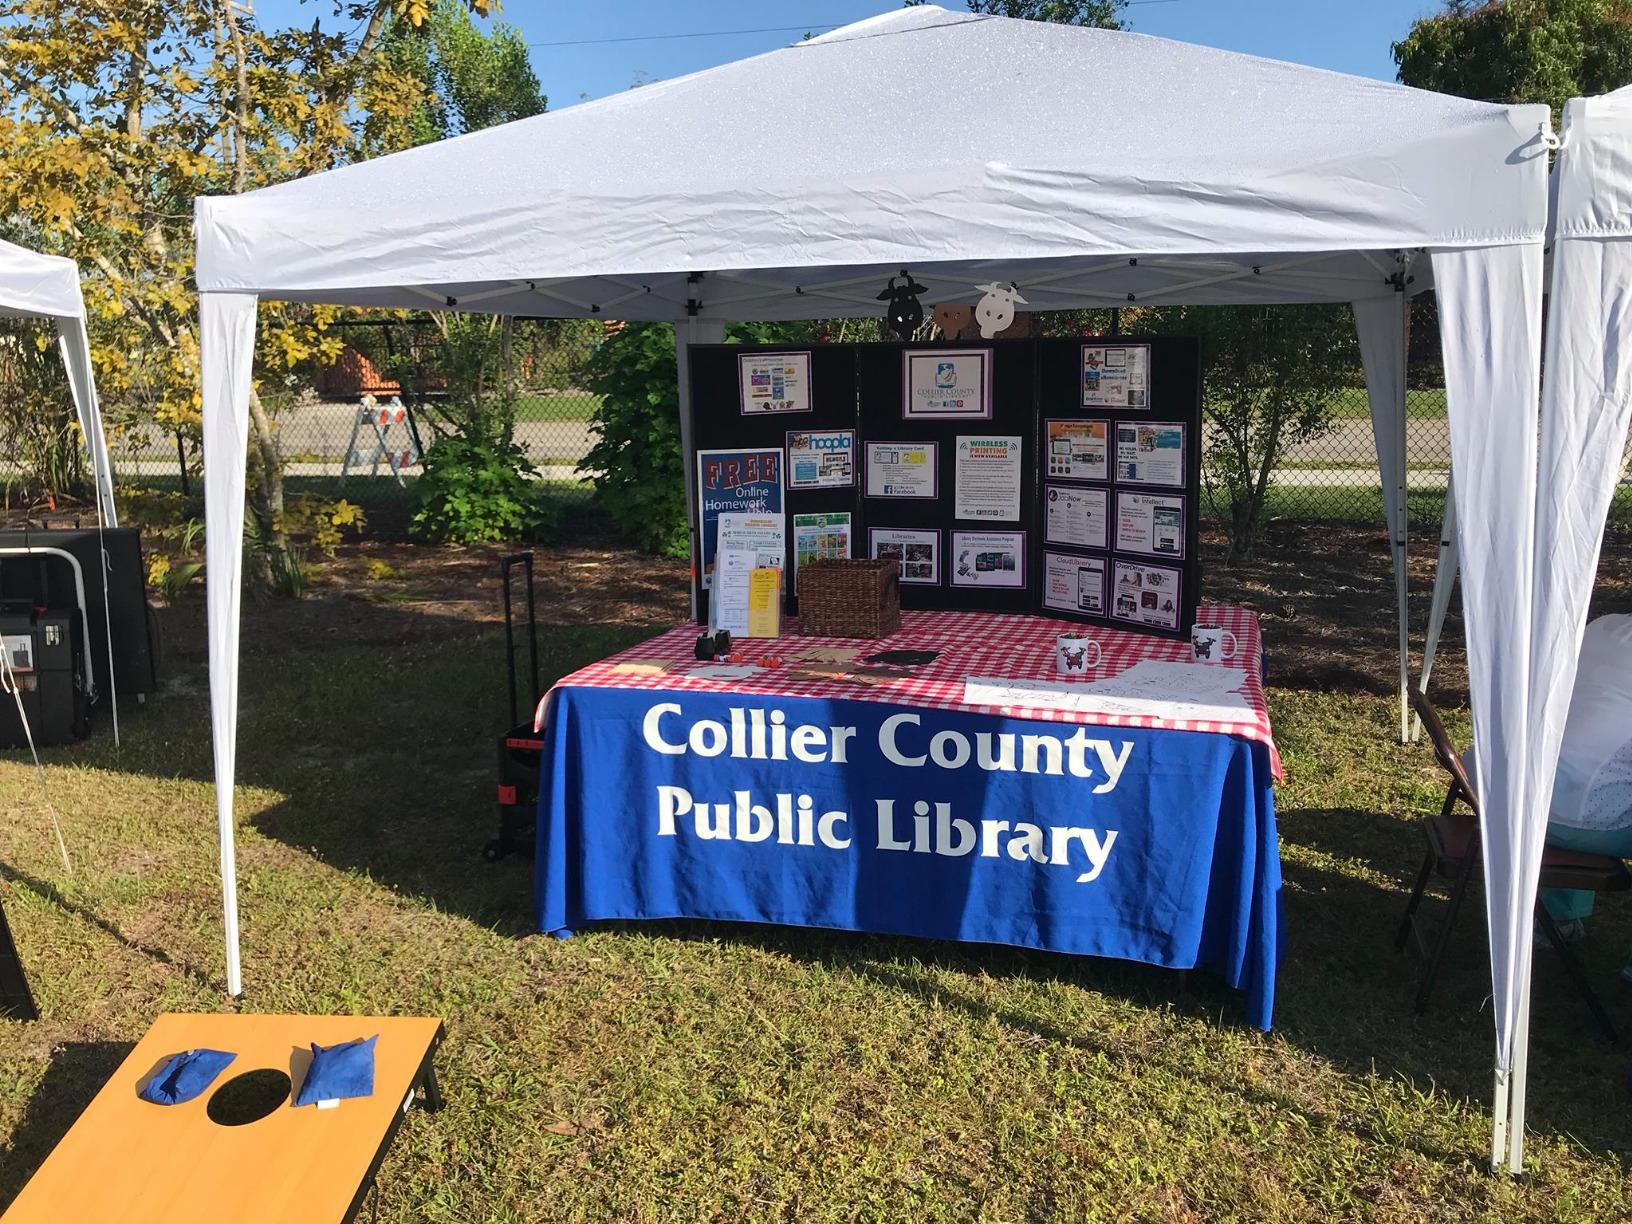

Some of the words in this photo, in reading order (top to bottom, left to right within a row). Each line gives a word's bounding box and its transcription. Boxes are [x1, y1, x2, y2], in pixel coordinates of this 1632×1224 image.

[808, 433, 851, 452] hoopla
[704, 454, 778, 490] FREE
[736, 486, 768, 498] Online
[705, 498, 766, 511] Homework
[1116, 562, 1146, 572] OverDrive
[642, 702, 858, 766] Collier
[878, 713, 1135, 795] County
[656, 785, 853, 851] Public
[875, 799, 1119, 884] Library
